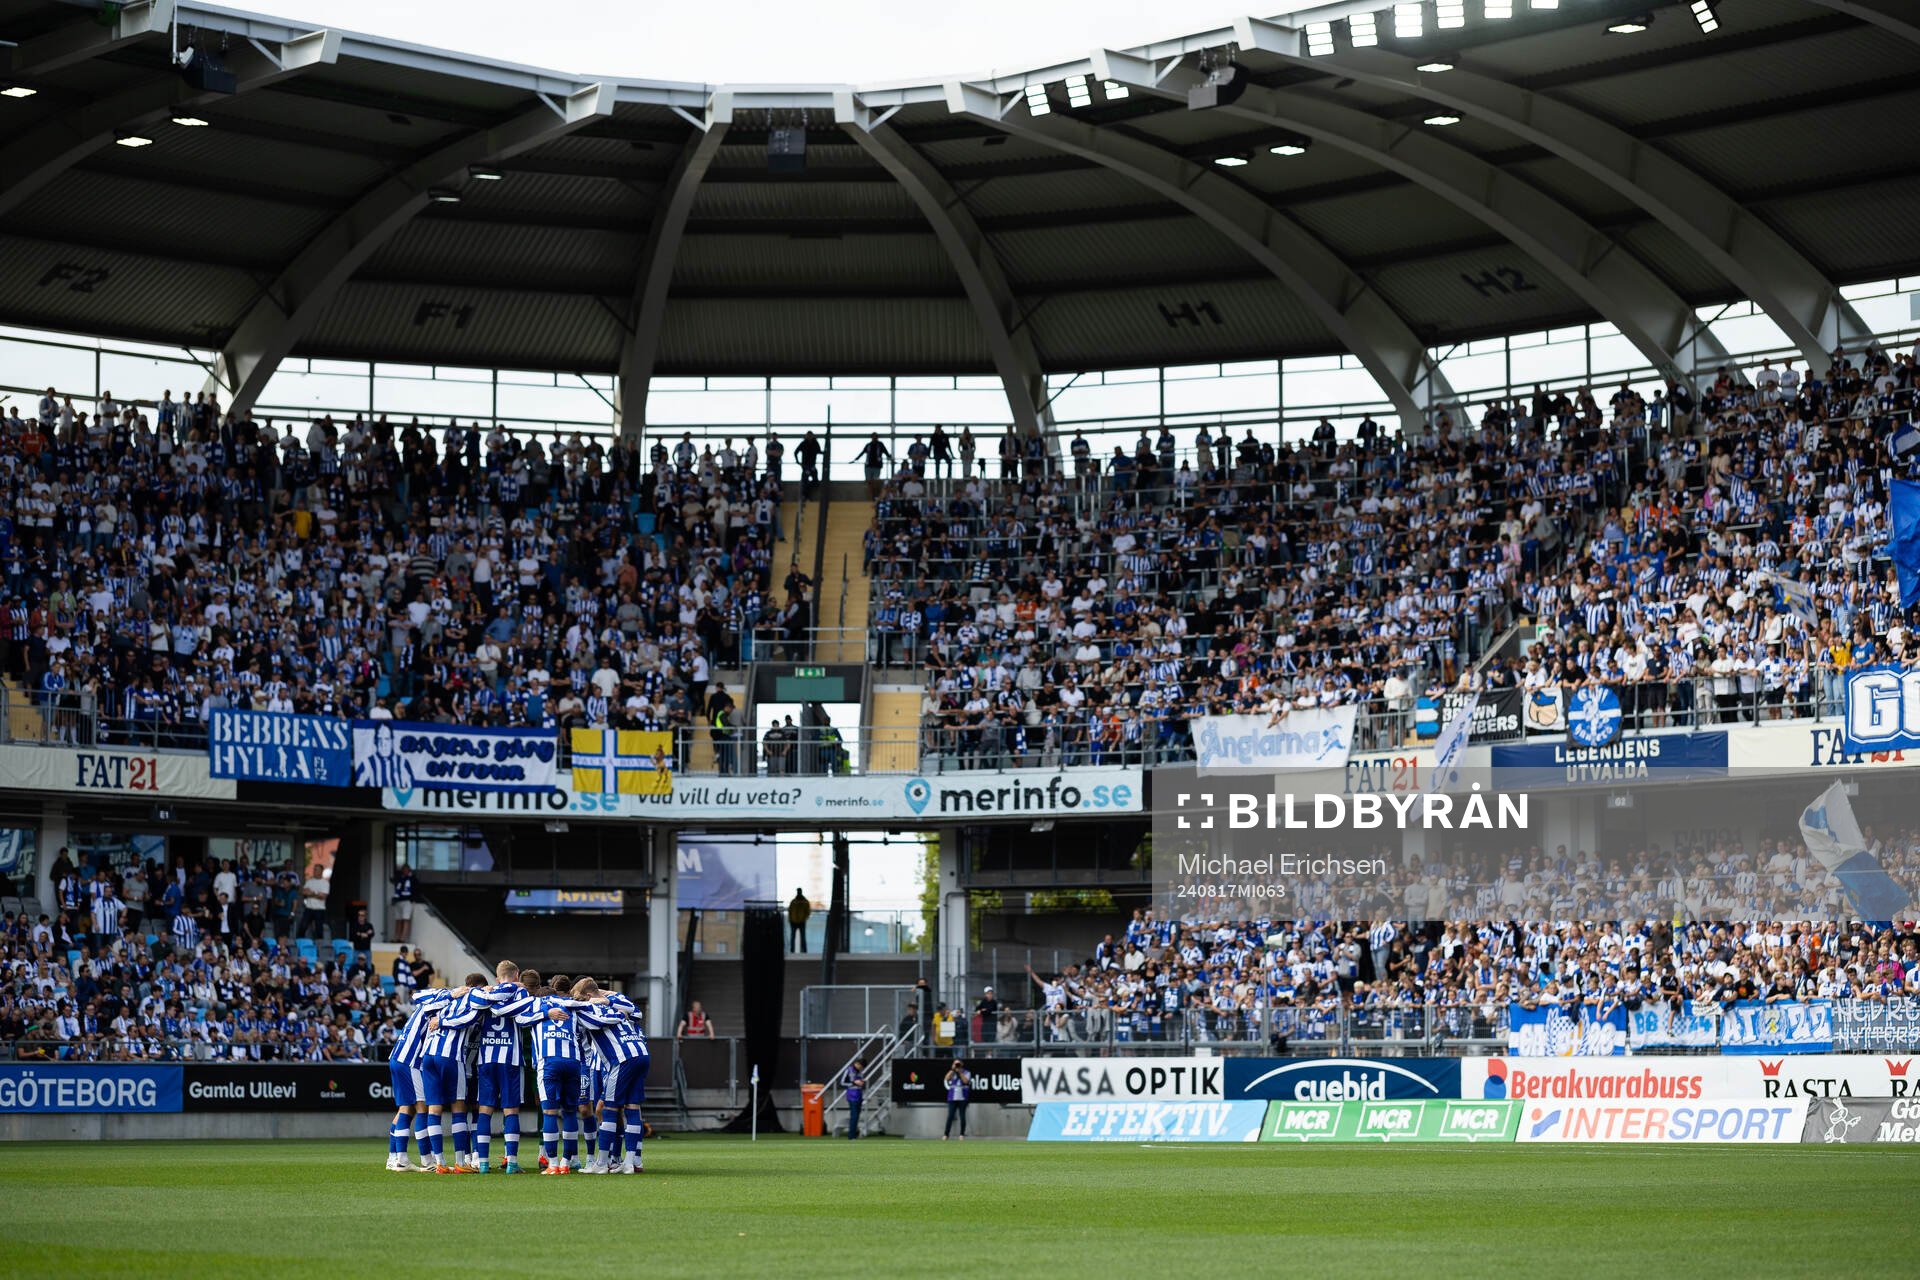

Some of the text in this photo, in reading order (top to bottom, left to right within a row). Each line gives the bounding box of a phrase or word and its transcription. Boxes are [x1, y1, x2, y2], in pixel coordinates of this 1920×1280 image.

[37, 264, 109, 293] F2
[1461, 267, 1537, 297] H2
[413, 303, 473, 329] F1
[1158, 301, 1224, 328] H1
[213, 712, 348, 750] BEBBENS
[1200, 720, 1321, 767] Änglarna
[75, 754, 160, 791] FAT21
[1566, 759, 1649, 783] UTVALDA
[679, 787, 709, 805] vill
[716, 787, 740, 805] du
[746, 788, 802, 805] veta?
[825, 795, 884, 807] merinfo.se
[940, 776, 1132, 812] merinfo.se
[482, 1037, 512, 1045] MOBILL
[544, 1031, 573, 1041] MOBILL
[0, 1071, 156, 1107] GÖTEBORG
[189, 1081, 296, 1099] Gamla Ullevi
[1027, 1066, 1220, 1096] WASA OPTIK
[1294, 1070, 1386, 1101] cuebid
[1763, 1078, 1853, 1099] RASTA
[1061, 1103, 1232, 1136] EFFEKTIV
[1284, 1109, 1331, 1130] MCR
[1366, 1108, 1411, 1130] MCR
[1450, 1108, 1499, 1129] MCR
[1562, 1107, 1793, 1140] INTERSPORT
